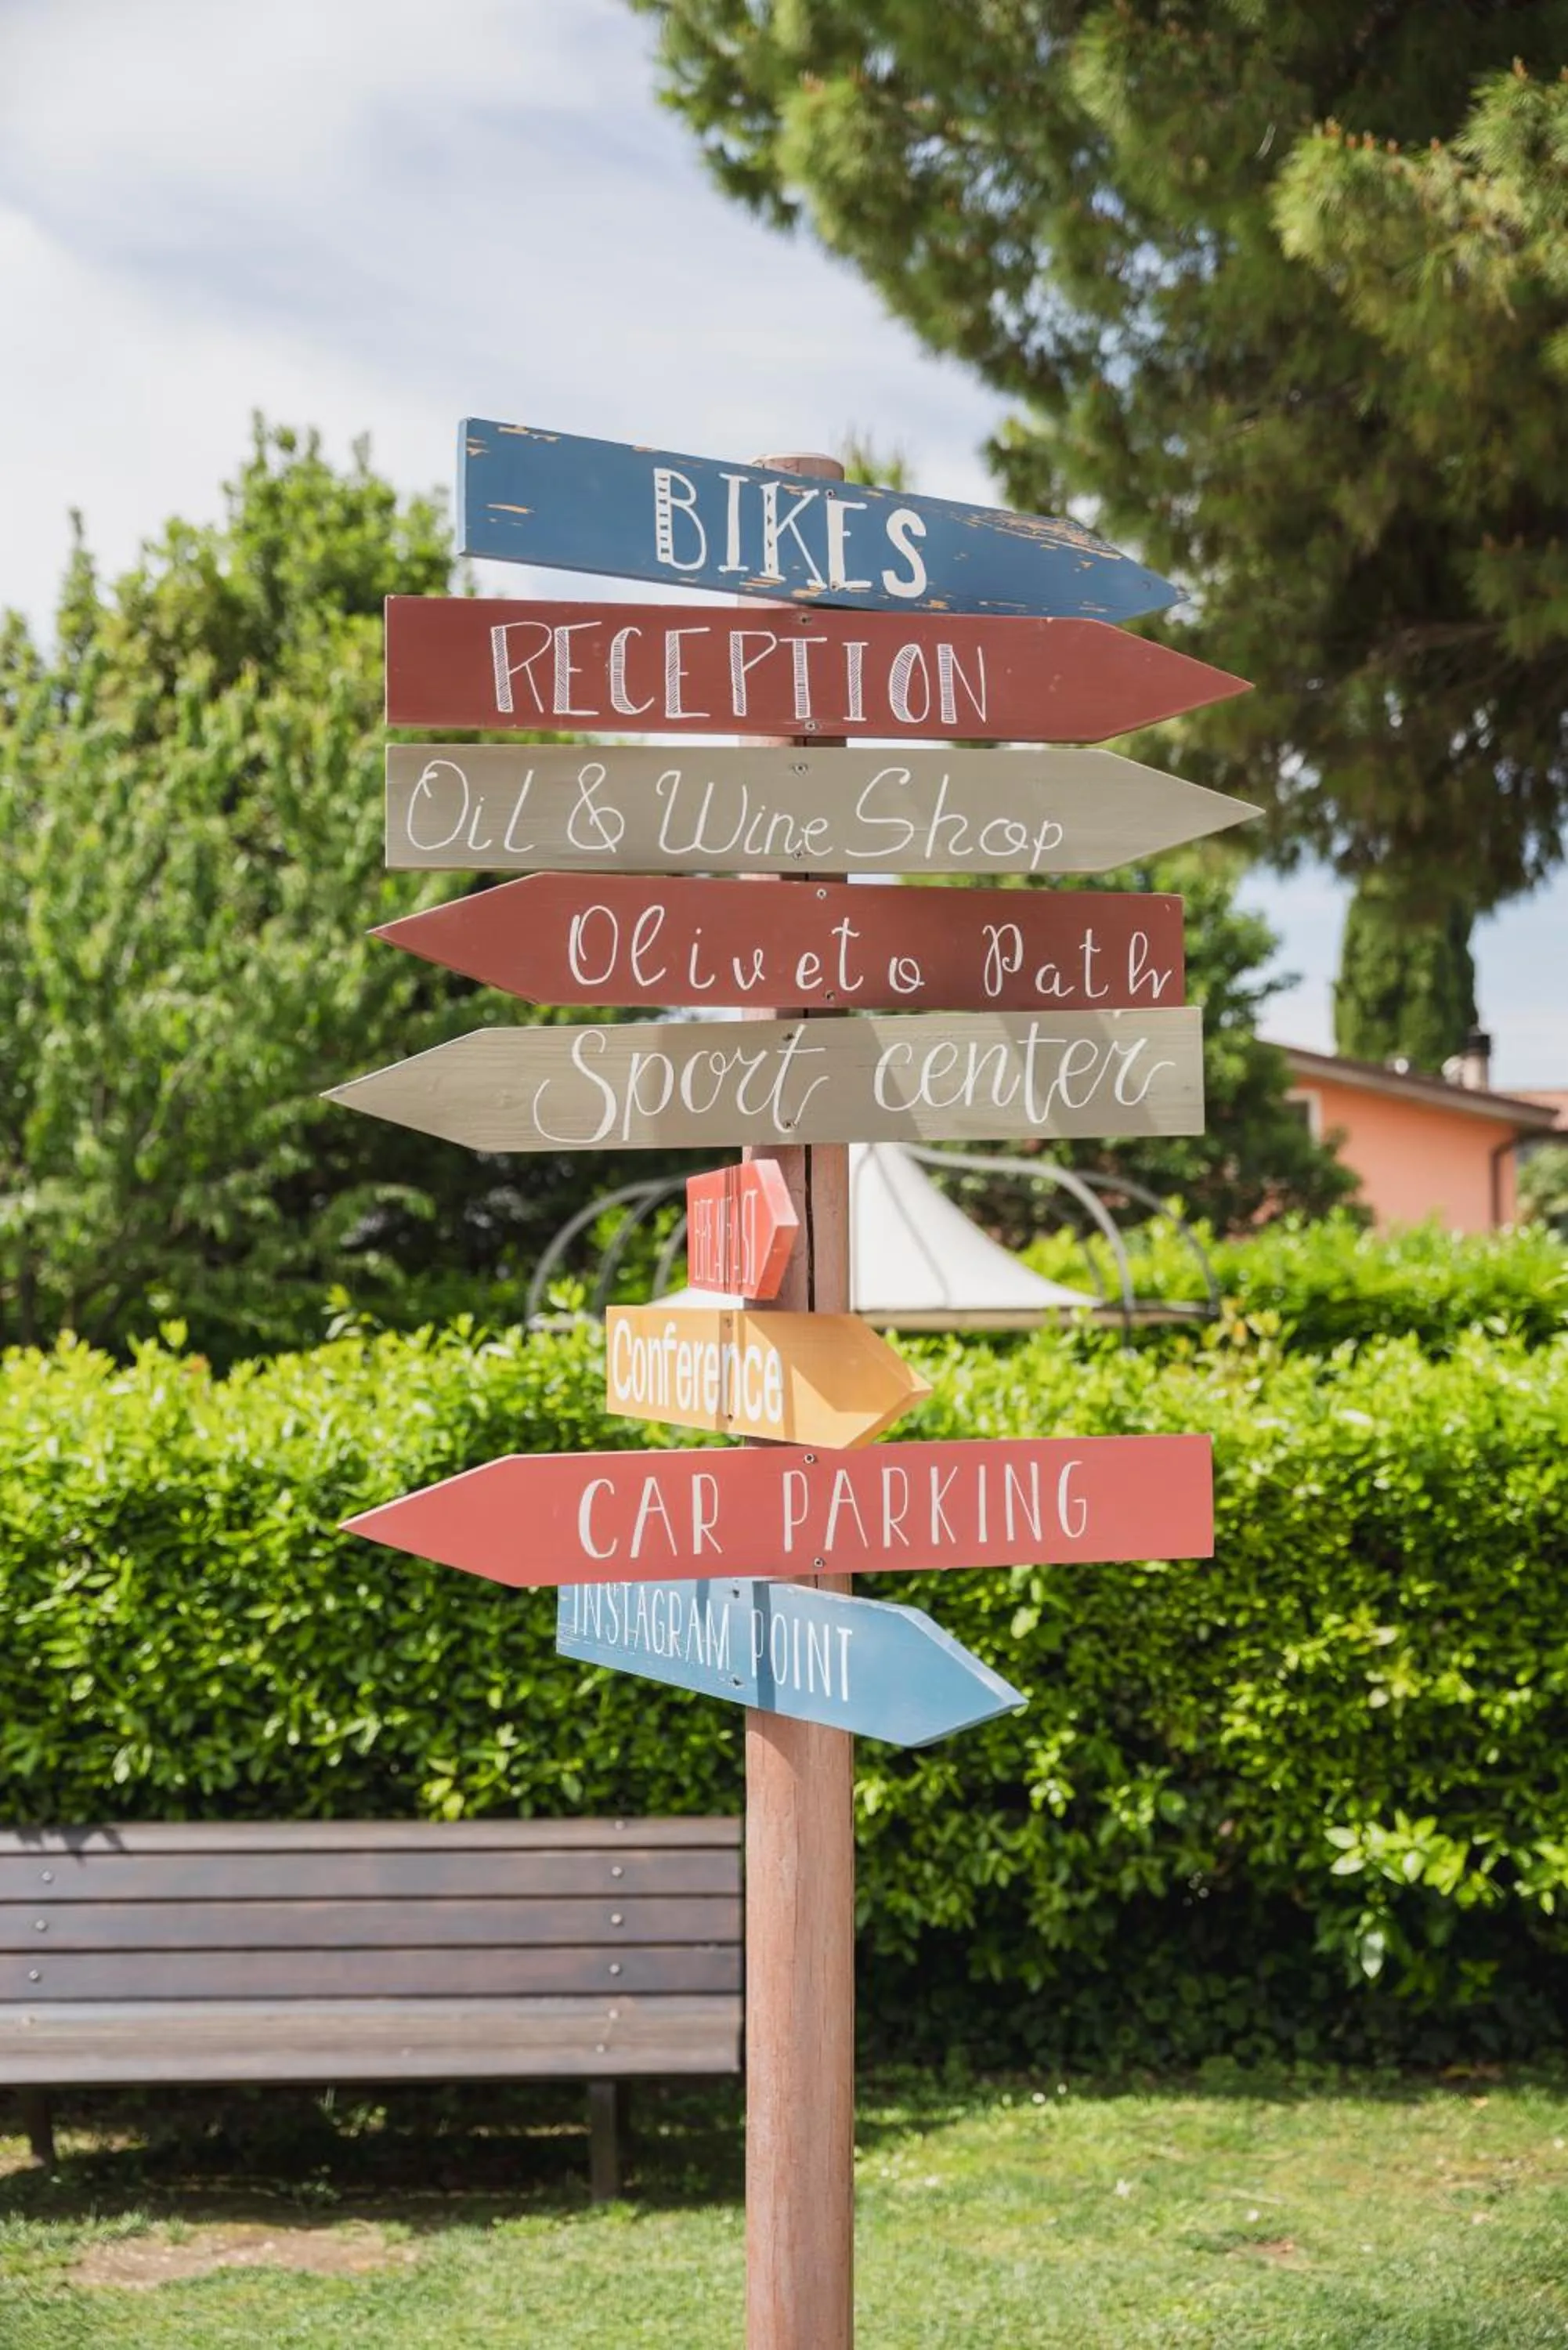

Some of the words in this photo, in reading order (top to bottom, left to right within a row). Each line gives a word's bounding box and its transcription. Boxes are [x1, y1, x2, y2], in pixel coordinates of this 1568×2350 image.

[653, 467, 927, 598] BIKES
[490, 620, 987, 724] RECEPTION
[406, 759, 536, 854] Oil
[567, 762, 626, 854] &
[656, 768, 833, 857] Wine
[845, 767, 1064, 870] Shop
[568, 904, 926, 989] Oliveto
[982, 922, 1172, 1000] Path
[533, 1024, 831, 1143] Sport
[873, 1021, 1176, 1125] center
[612, 1318, 783, 1424] Conference
[576, 1473, 724, 1560] CAR
[782, 1459, 1089, 1553] PARKING
[572, 1581, 731, 1671] INSTAGRAM
[750, 1608, 854, 1702] POINT
